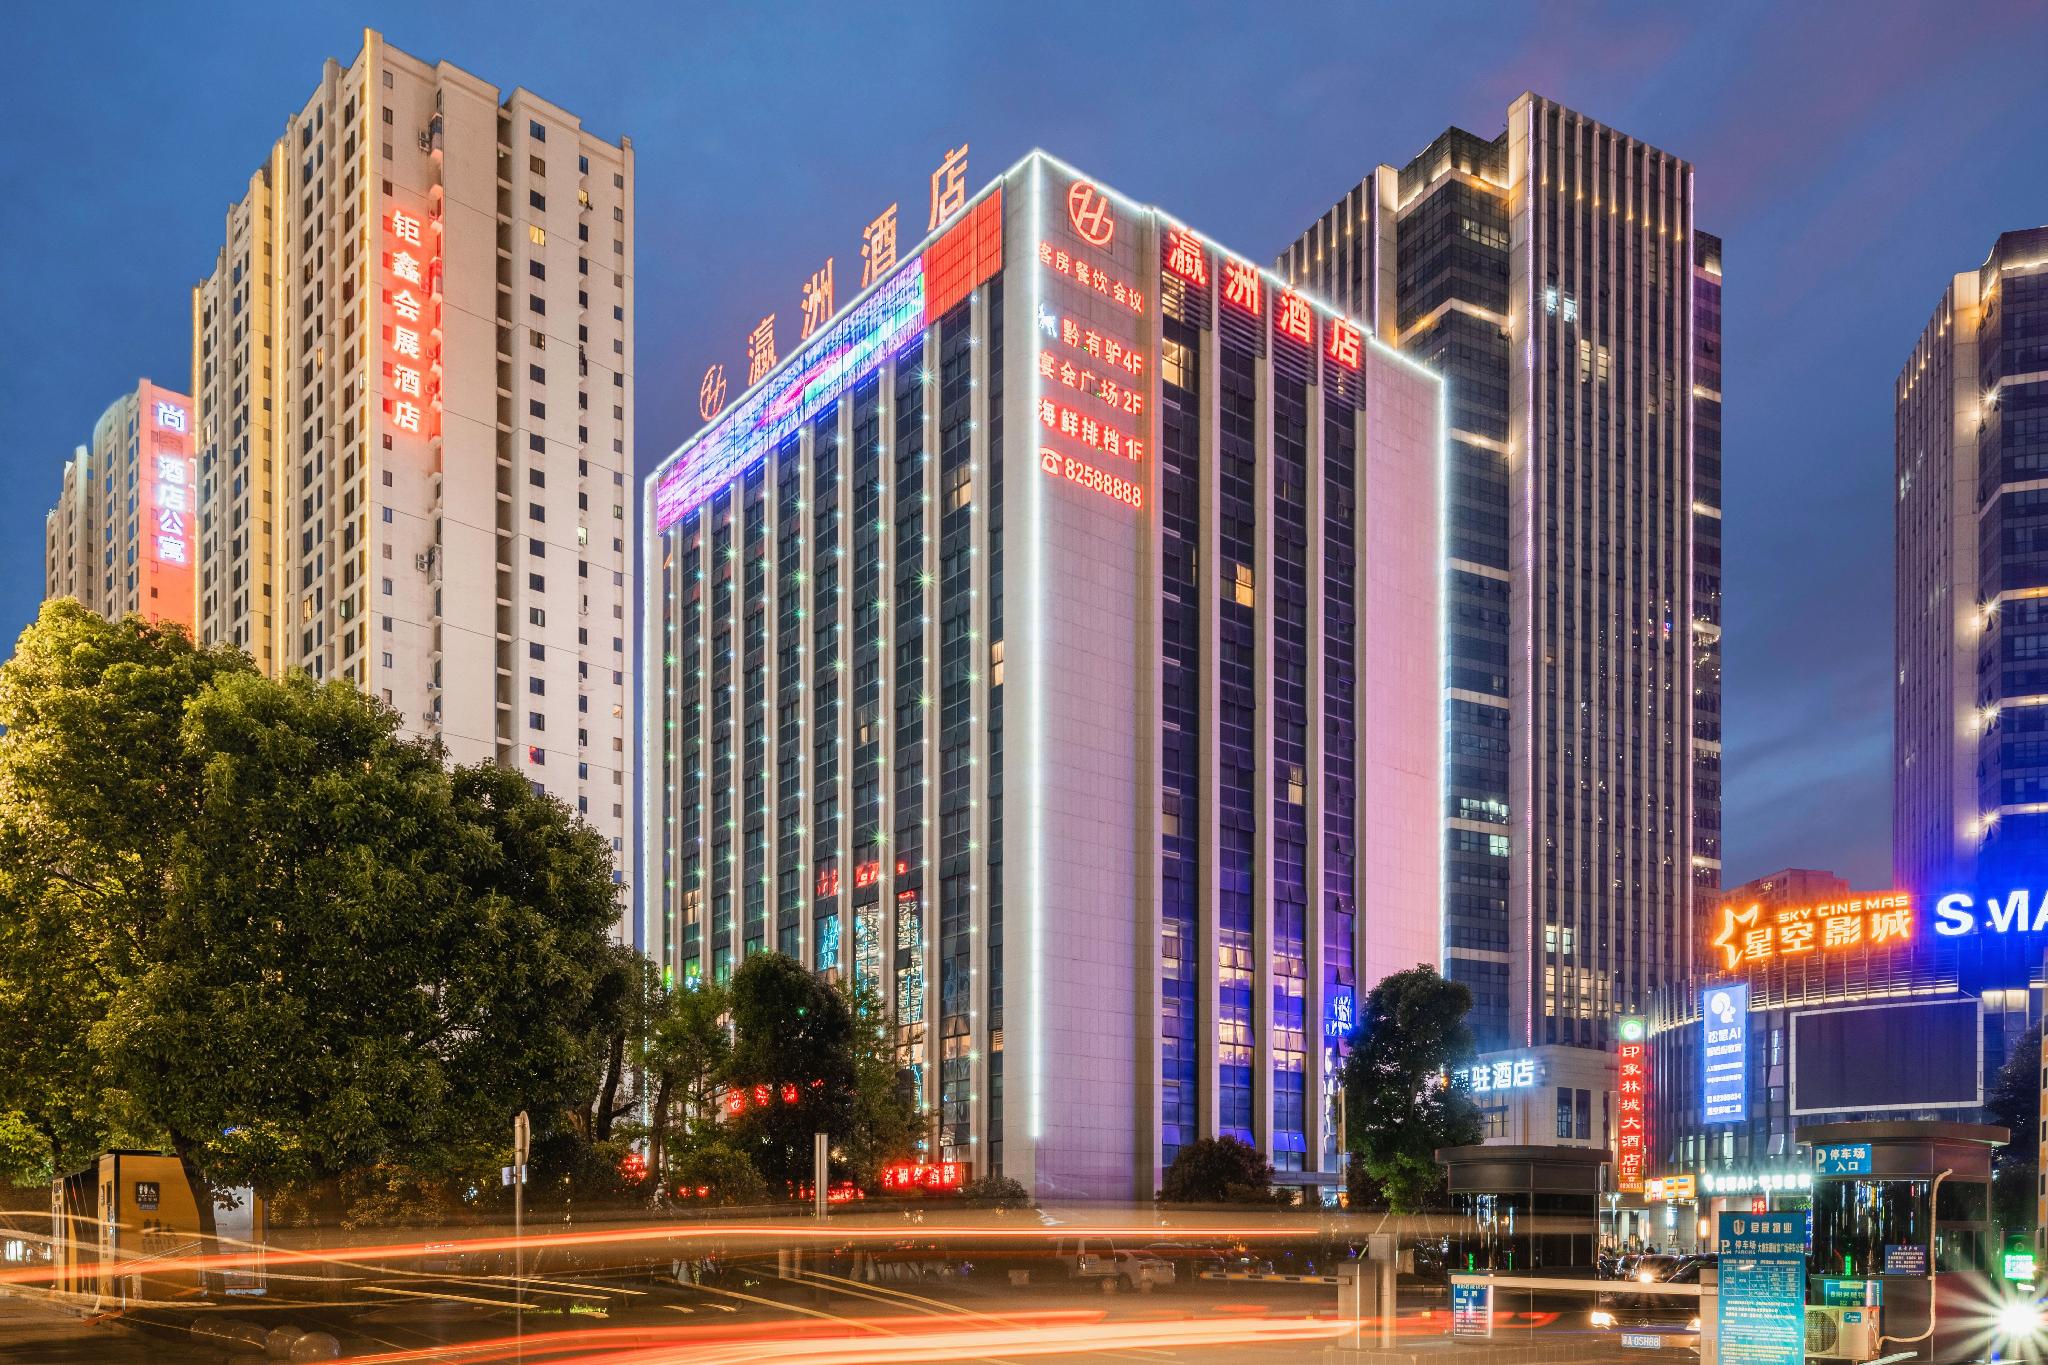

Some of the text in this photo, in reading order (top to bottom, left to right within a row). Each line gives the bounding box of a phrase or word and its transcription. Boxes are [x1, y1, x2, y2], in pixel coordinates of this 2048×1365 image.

[1170, 230, 1360, 368] 瀛洲酒店
[392, 210, 421, 433] 钜鑫会展酒店
[1065, 458, 1142, 507] 82588888
[1746, 909, 1911, 960] 星空影城
[1778, 908, 1811, 923] SKY
[1451, 1060, 1534, 1092] 驻酒店
[1830, 1147, 1866, 1160] 停车场
[1836, 1161, 1858, 1172] 入口
